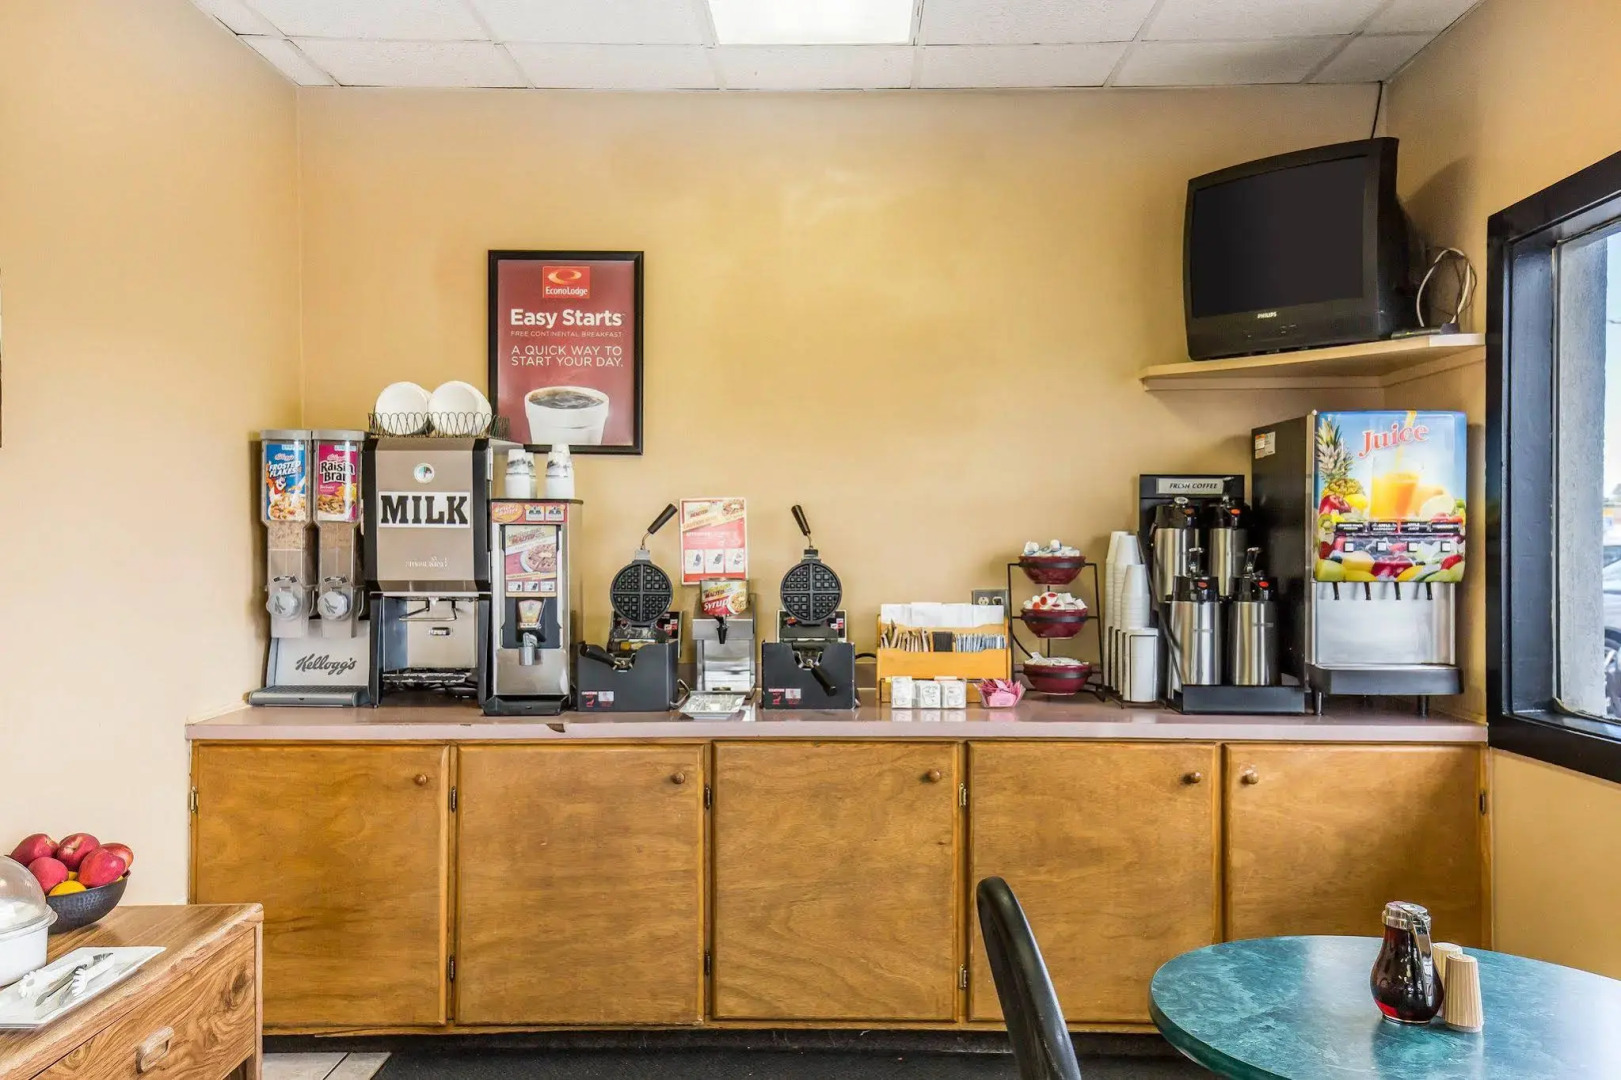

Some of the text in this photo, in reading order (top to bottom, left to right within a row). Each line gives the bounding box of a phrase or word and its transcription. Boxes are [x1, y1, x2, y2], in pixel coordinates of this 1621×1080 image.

[545, 286, 588, 297] EconoLodge
[510, 308, 622, 329] Easy Starts
[1257, 311, 1278, 319] PHILIPS
[581, 330, 622, 338] BREAKFAST
[511, 345, 622, 356] A QUICK WAY TO
[511, 357, 624, 368] START YOUR DAY.
[1358, 423, 1430, 458] Juice
[270, 467, 297, 478] FLAKES
[380, 495, 469, 525] MILK
[703, 598, 730, 611] Syrup
[295, 653, 357, 676] Kellogg's
